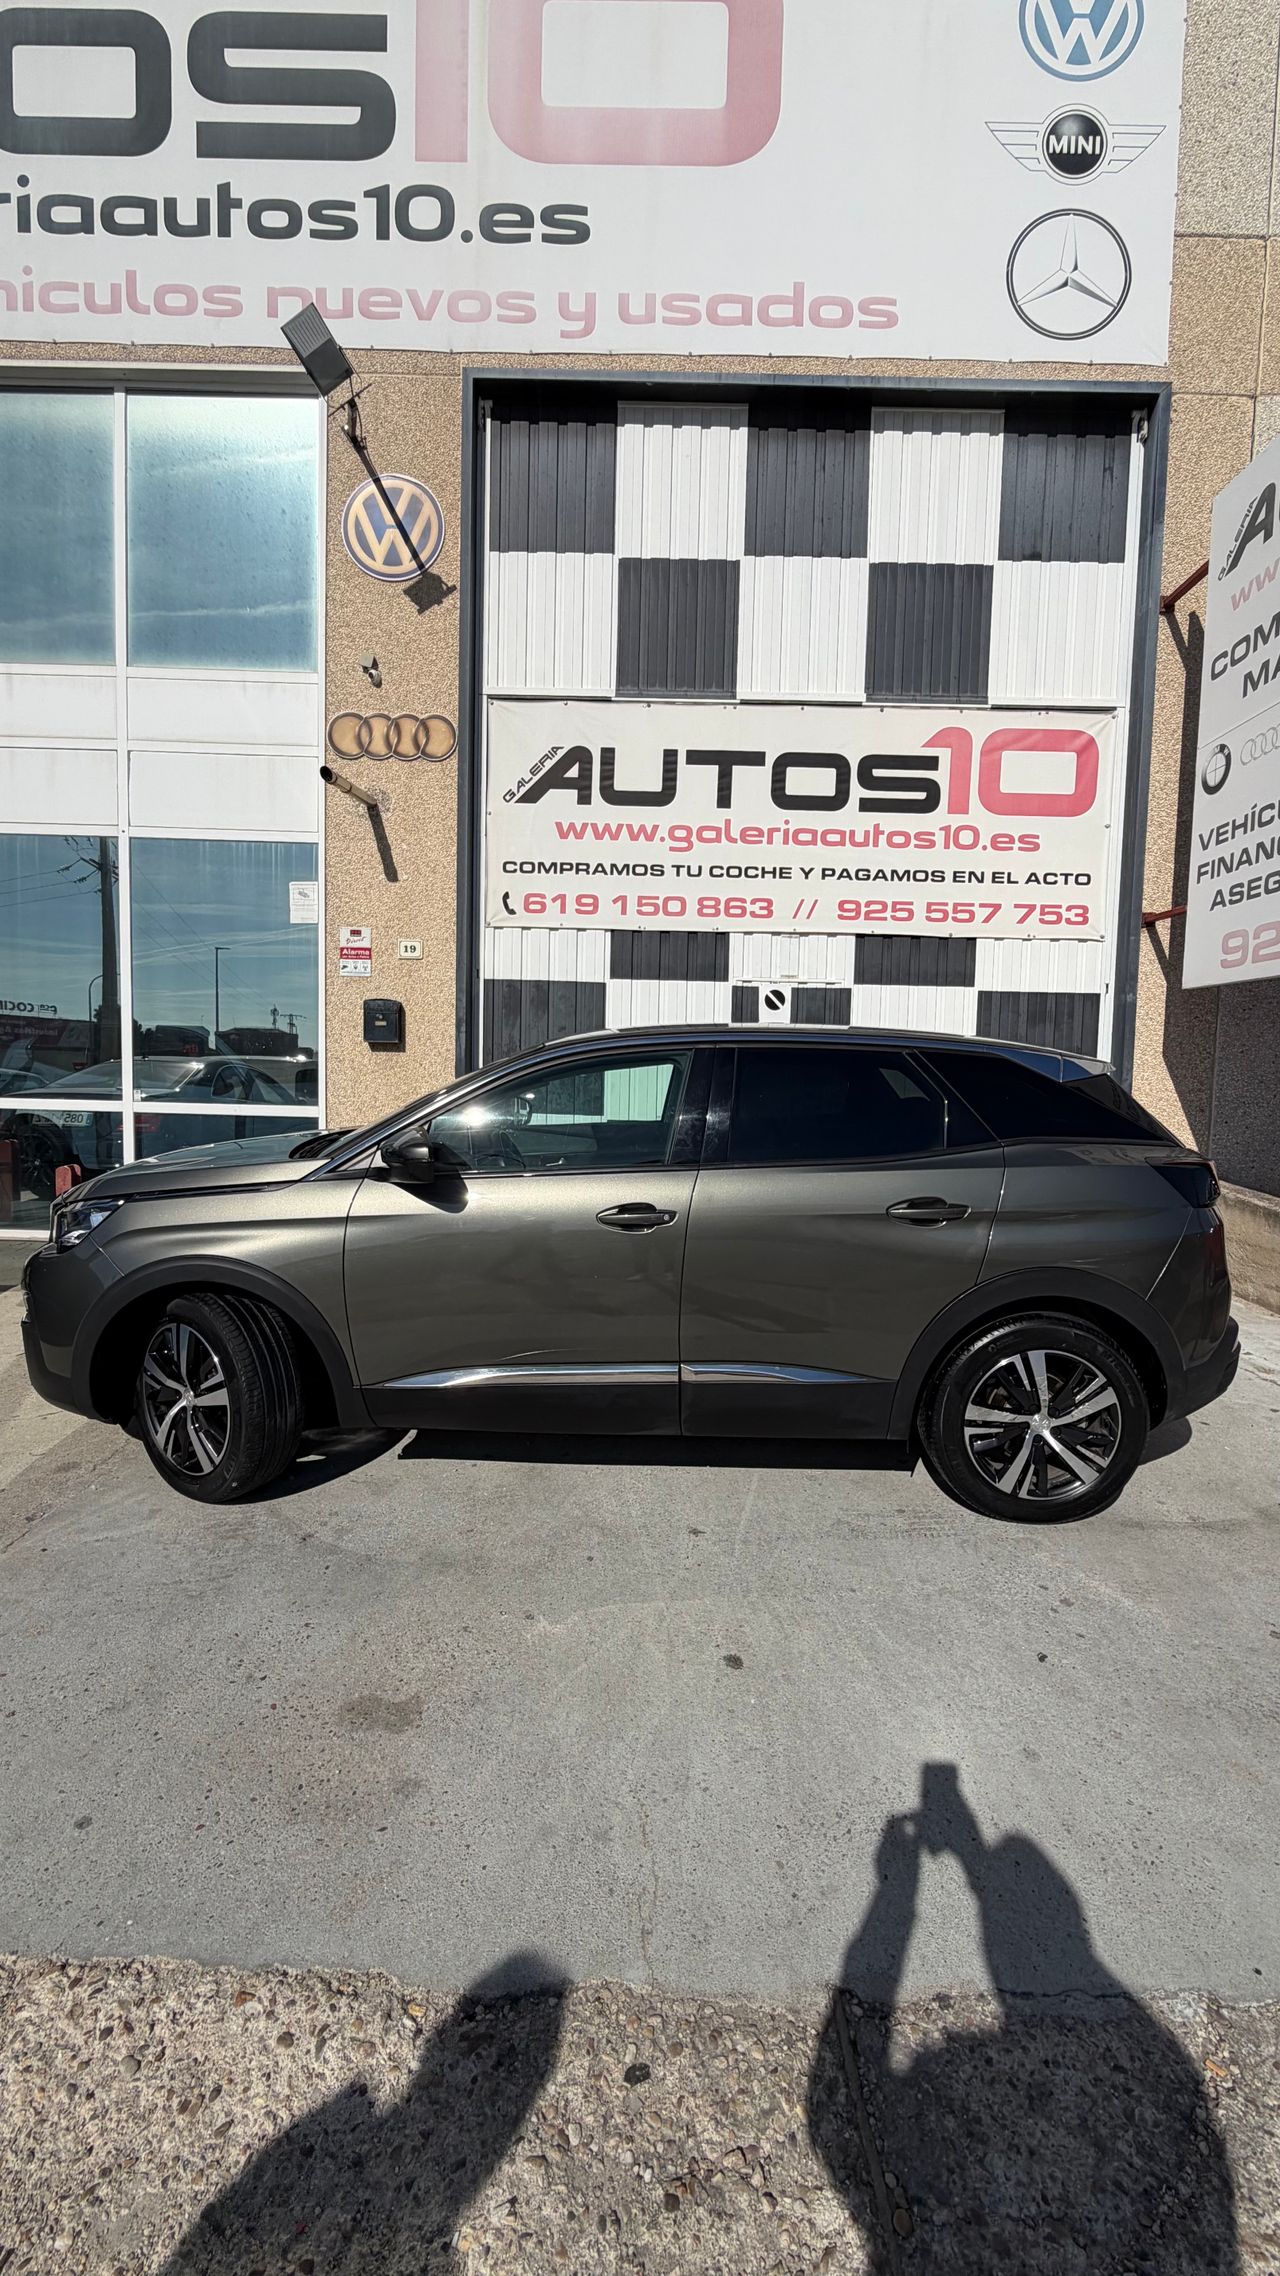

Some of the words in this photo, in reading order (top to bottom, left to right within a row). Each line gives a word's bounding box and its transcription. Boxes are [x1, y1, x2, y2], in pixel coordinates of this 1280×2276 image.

[1048, 134, 1101, 155] MINI
[266, 285, 537, 325] nuevos
[557, 291, 597, 340] y
[617, 281, 899, 330] usados
[502, 746, 565, 804] GALERIA
[513, 726, 1100, 817] AUTOS10
[554, 818, 1041, 853] www.galeriaautos10.es
[1198, 803, 1280, 851] VEHÍC
[502, 861, 665, 877] COMPRAMOS
[671, 864, 702, 878] TU
[708, 865, 793, 880] COCHE
[799, 867, 815, 880] Y
[821, 867, 946, 883] PAGAMOS
[952, 870, 985, 884] EN
[991, 871, 1019, 885] EL
[1024, 872, 1092, 886] ACTO
[523, 892, 600, 915] 619
[611, 894, 687, 917] 150
[696, 896, 775, 919] 863
[836, 899, 916, 922] 925
[925, 901, 1003, 925] 557
[1012, 903, 1090, 926] 753
[404, 945, 417, 953] 19
